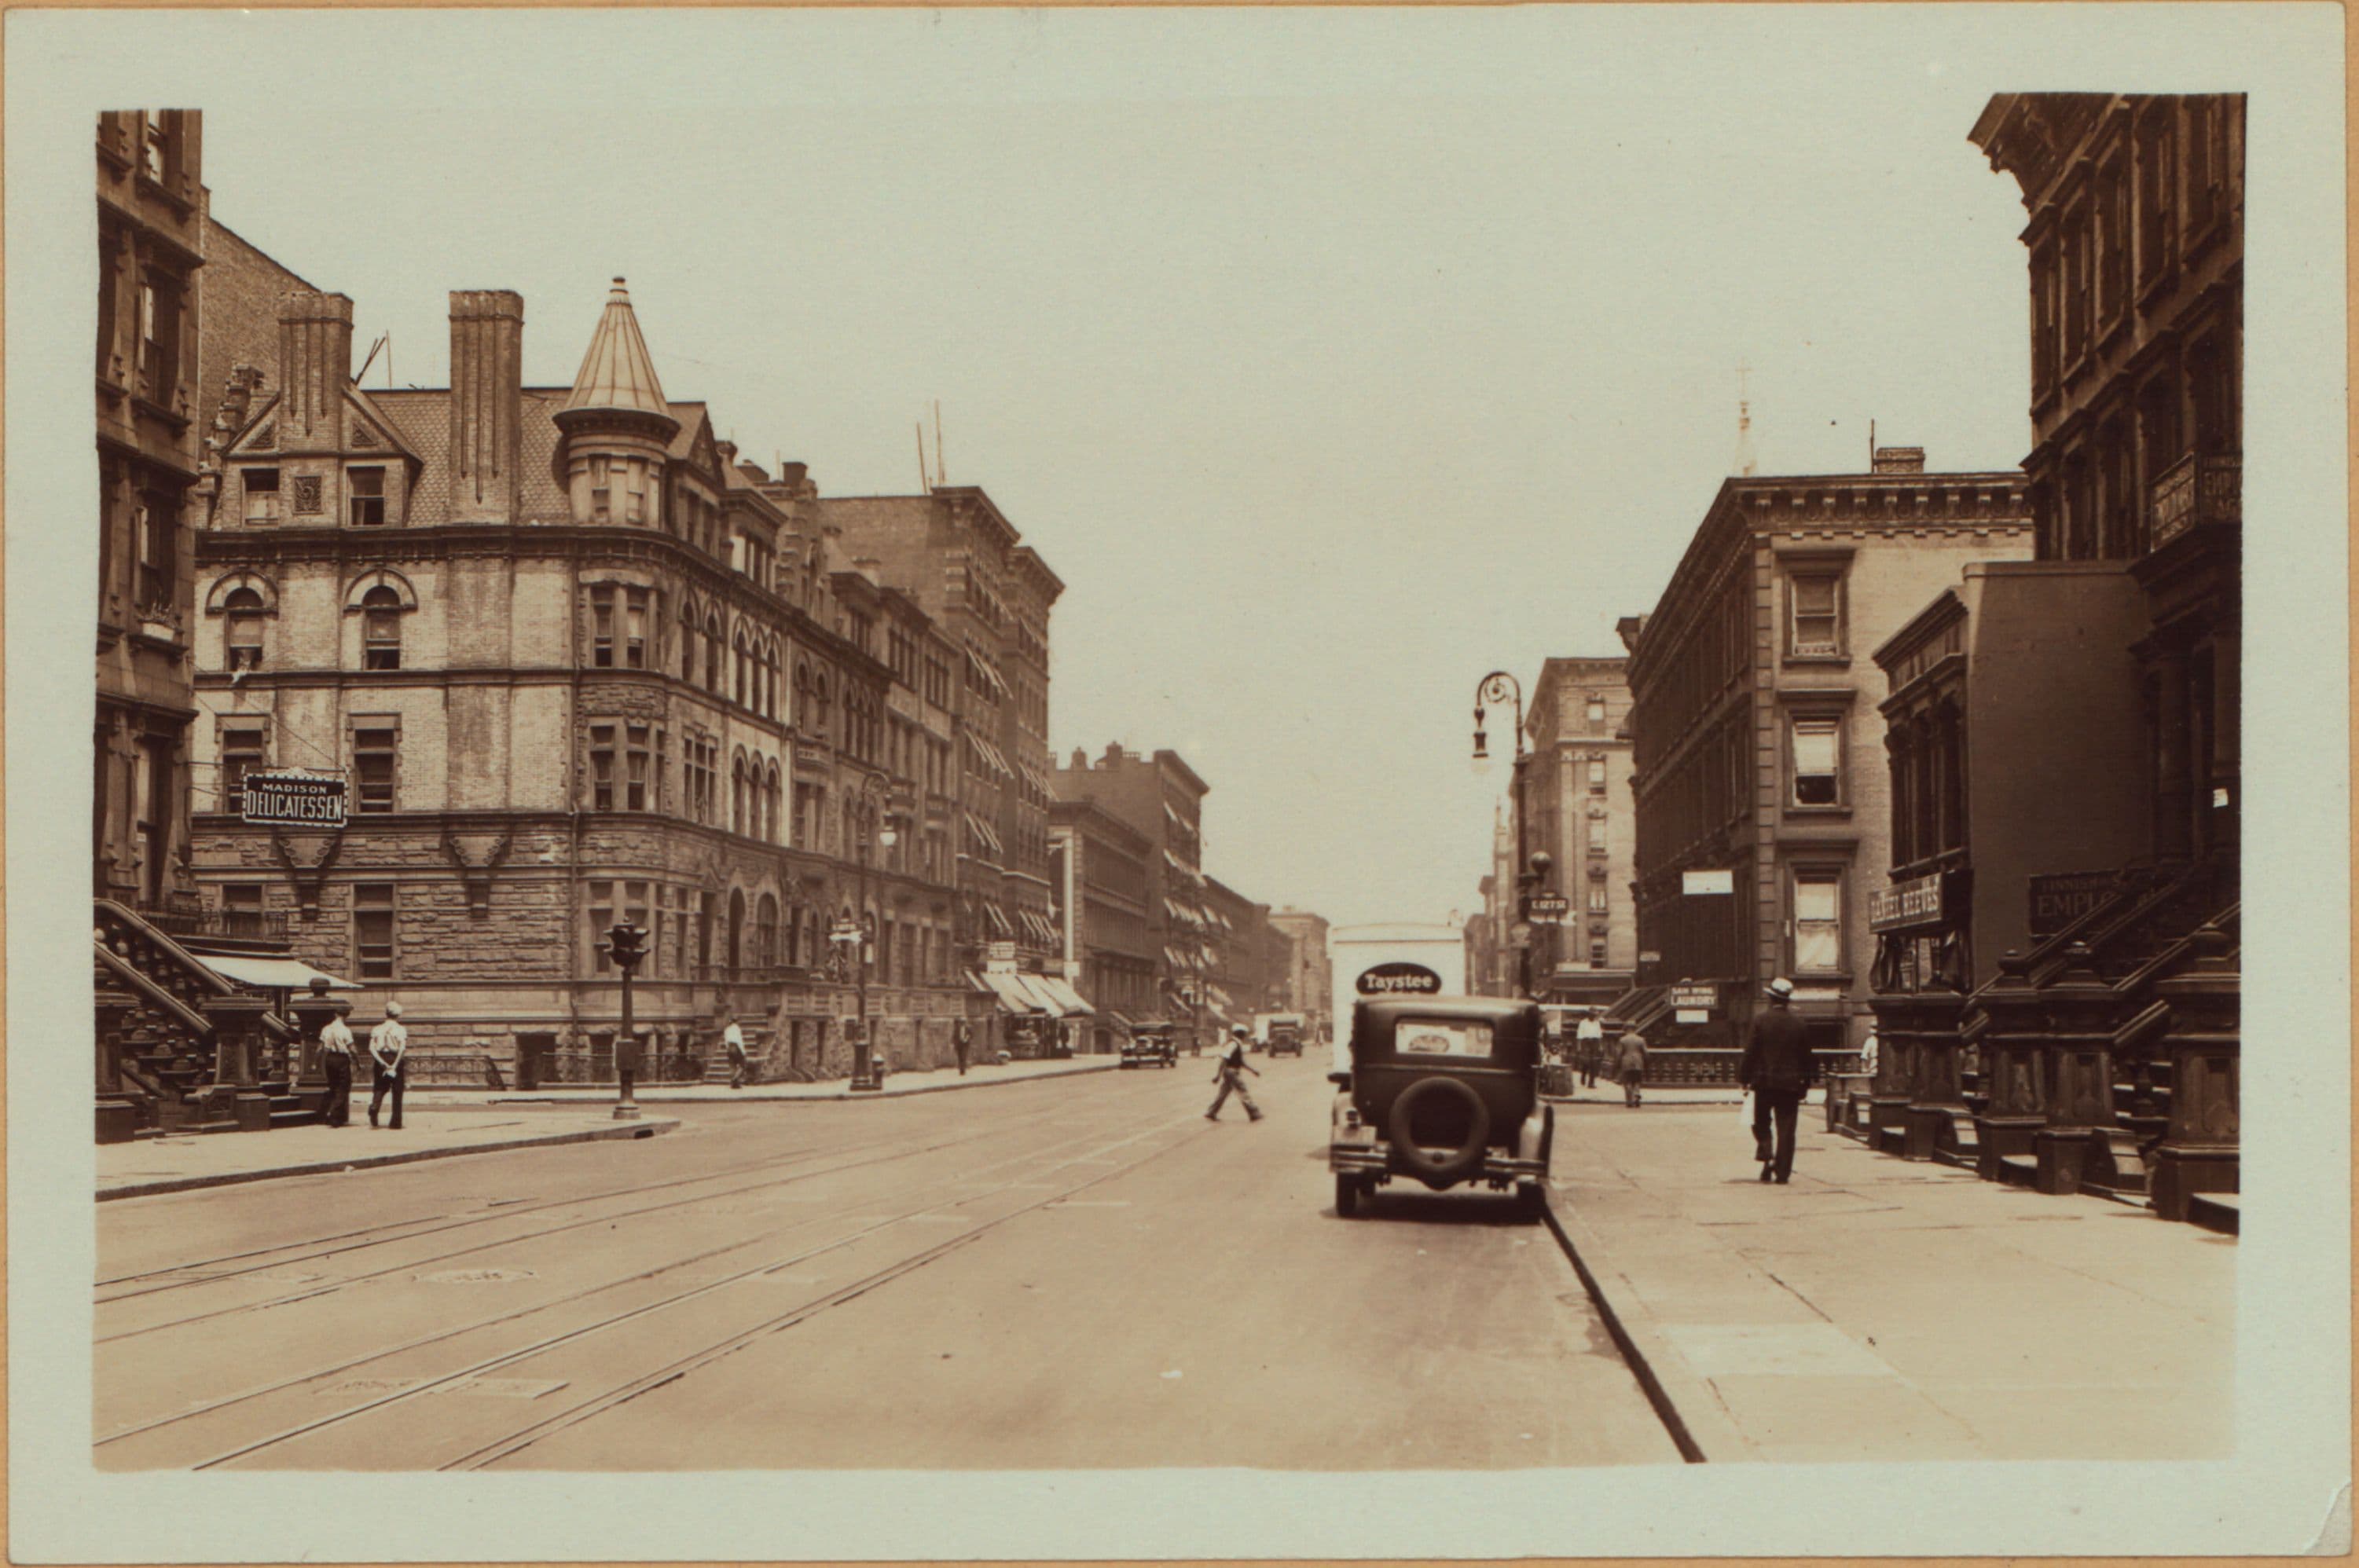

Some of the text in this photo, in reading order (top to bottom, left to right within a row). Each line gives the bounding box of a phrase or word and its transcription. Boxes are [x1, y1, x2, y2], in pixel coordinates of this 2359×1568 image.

[262, 783, 328, 794] MADISON
[247, 789, 343, 820] DELICATESSEN
[1902, 886, 1939, 917] REEVES
[1364, 973, 1433, 993] Taystee
[1671, 995, 1716, 1006] LAUNDRY
